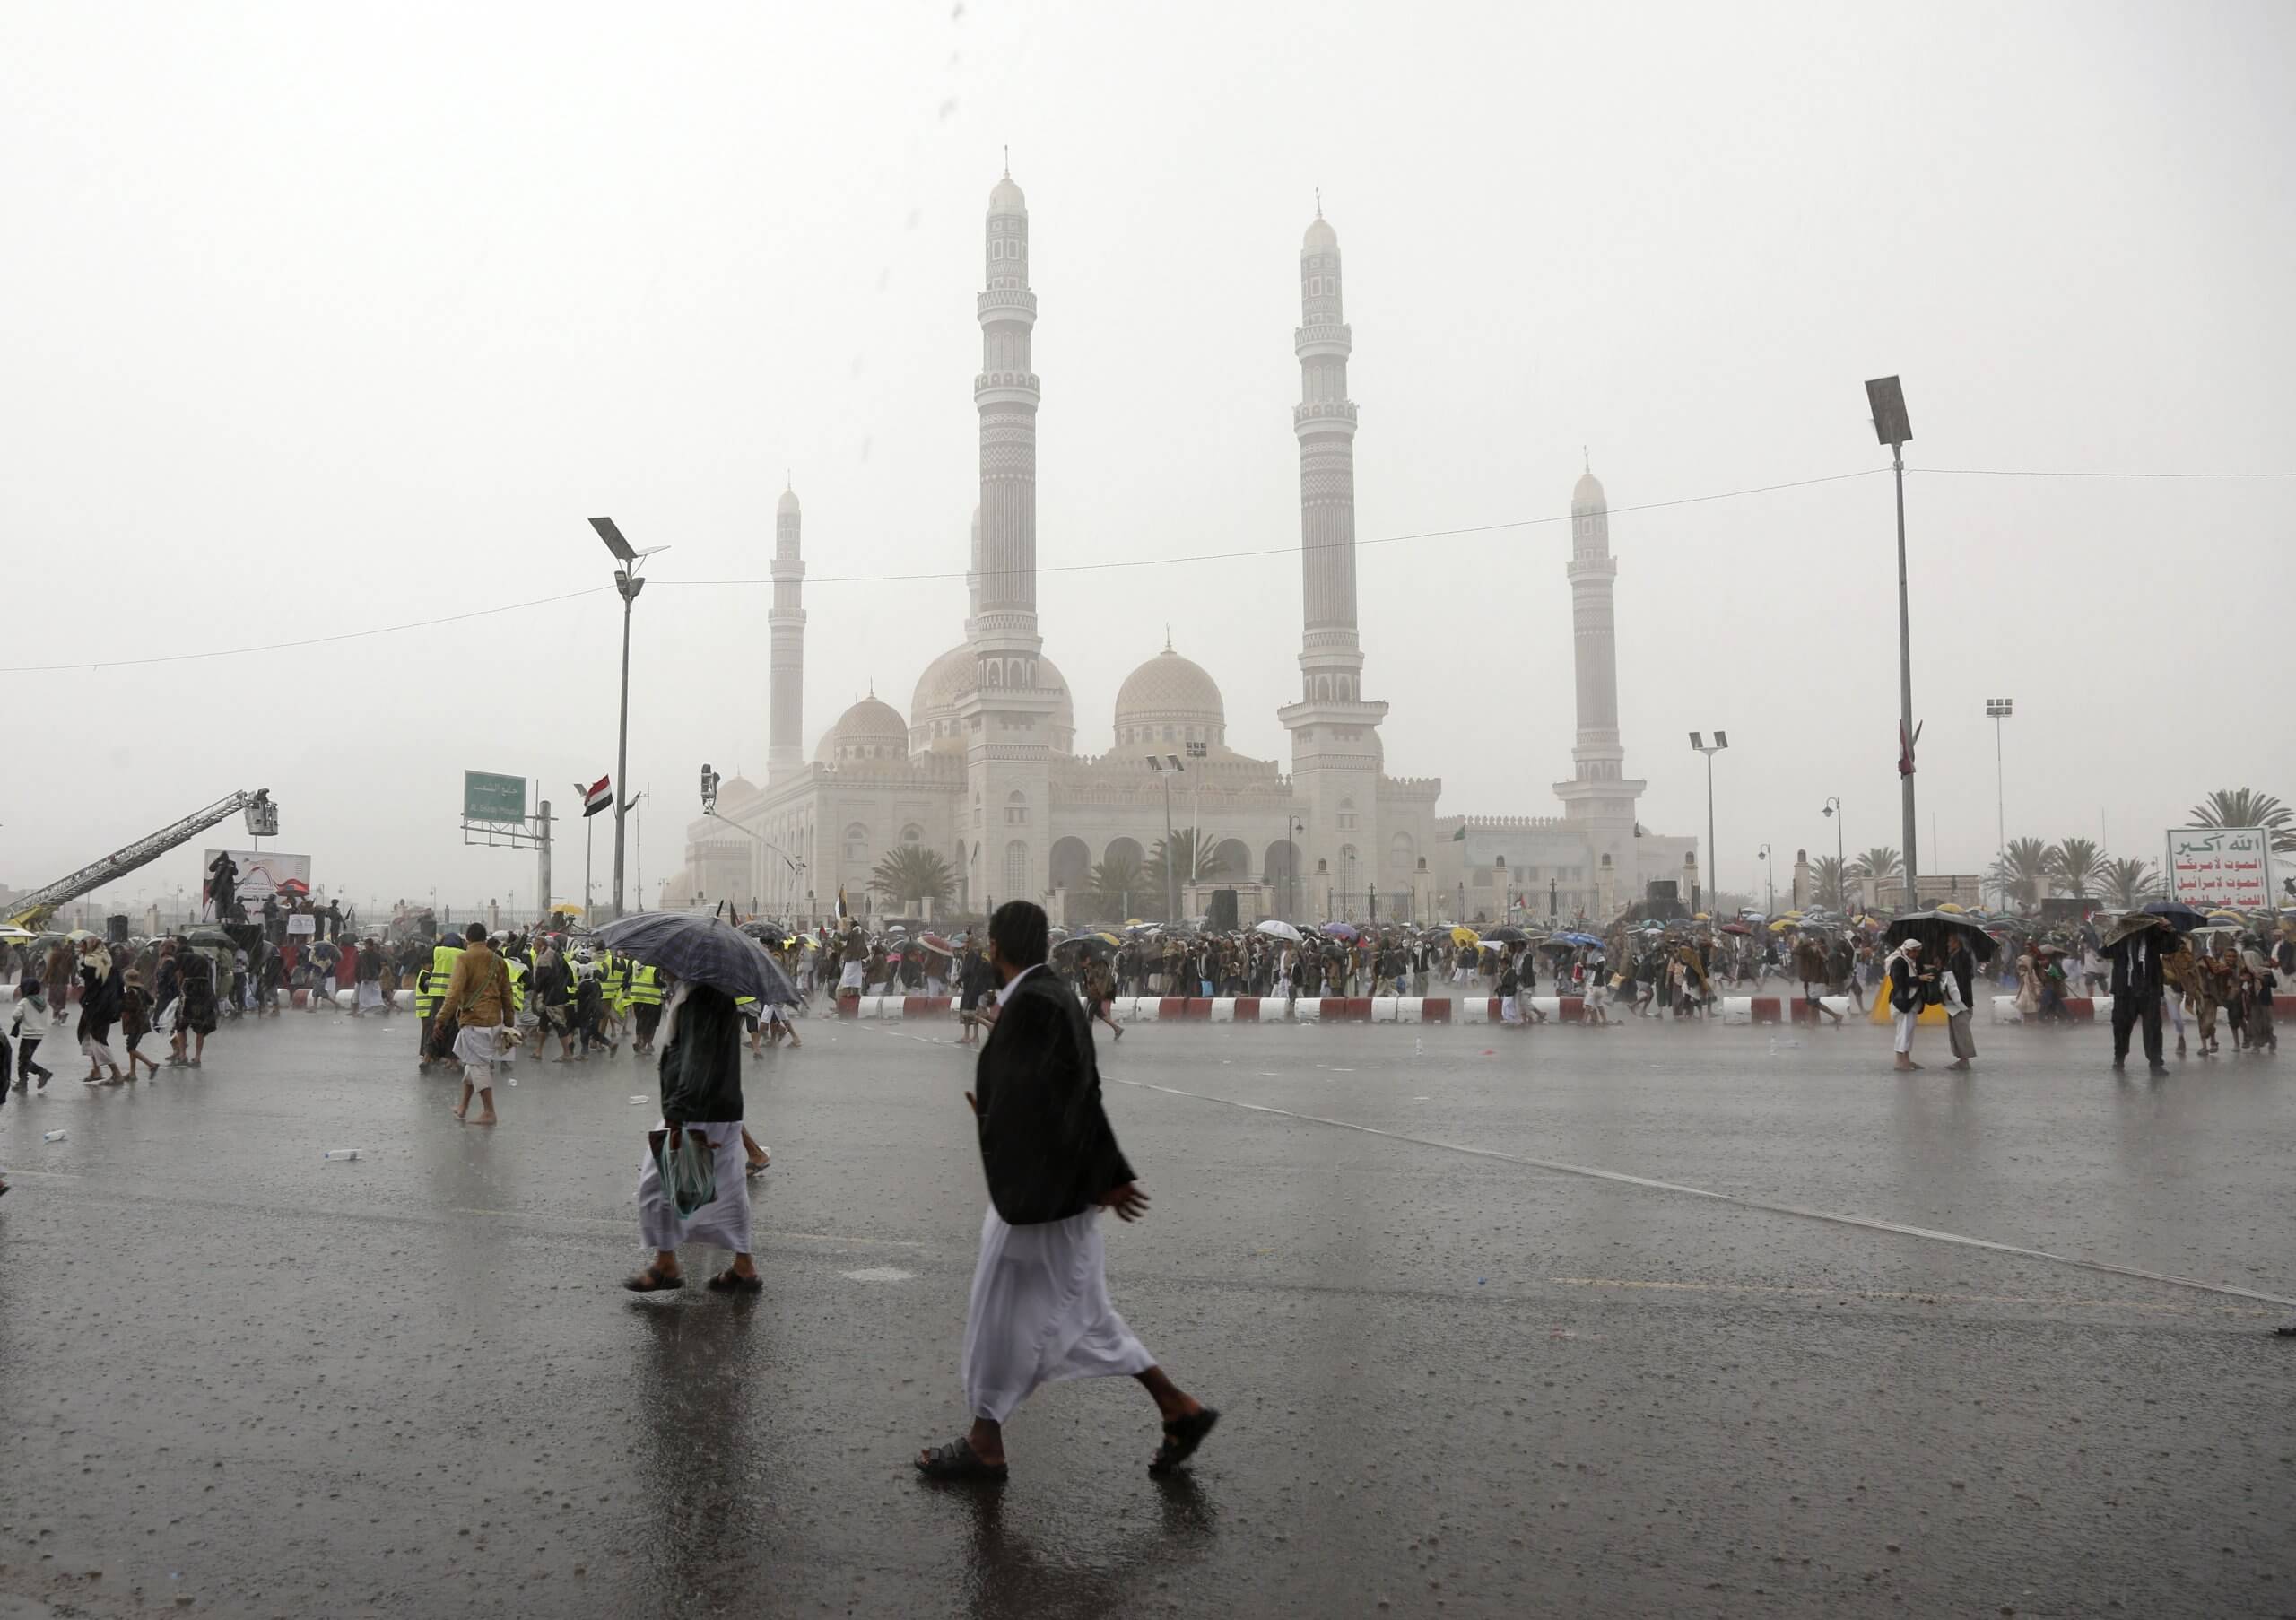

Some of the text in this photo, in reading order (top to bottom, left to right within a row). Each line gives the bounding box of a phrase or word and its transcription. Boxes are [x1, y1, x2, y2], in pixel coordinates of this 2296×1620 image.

[2175, 832, 2260, 857] الله أكبر
[2224, 858, 2262, 872] الموت
[2226, 876, 2264, 891] الموت
